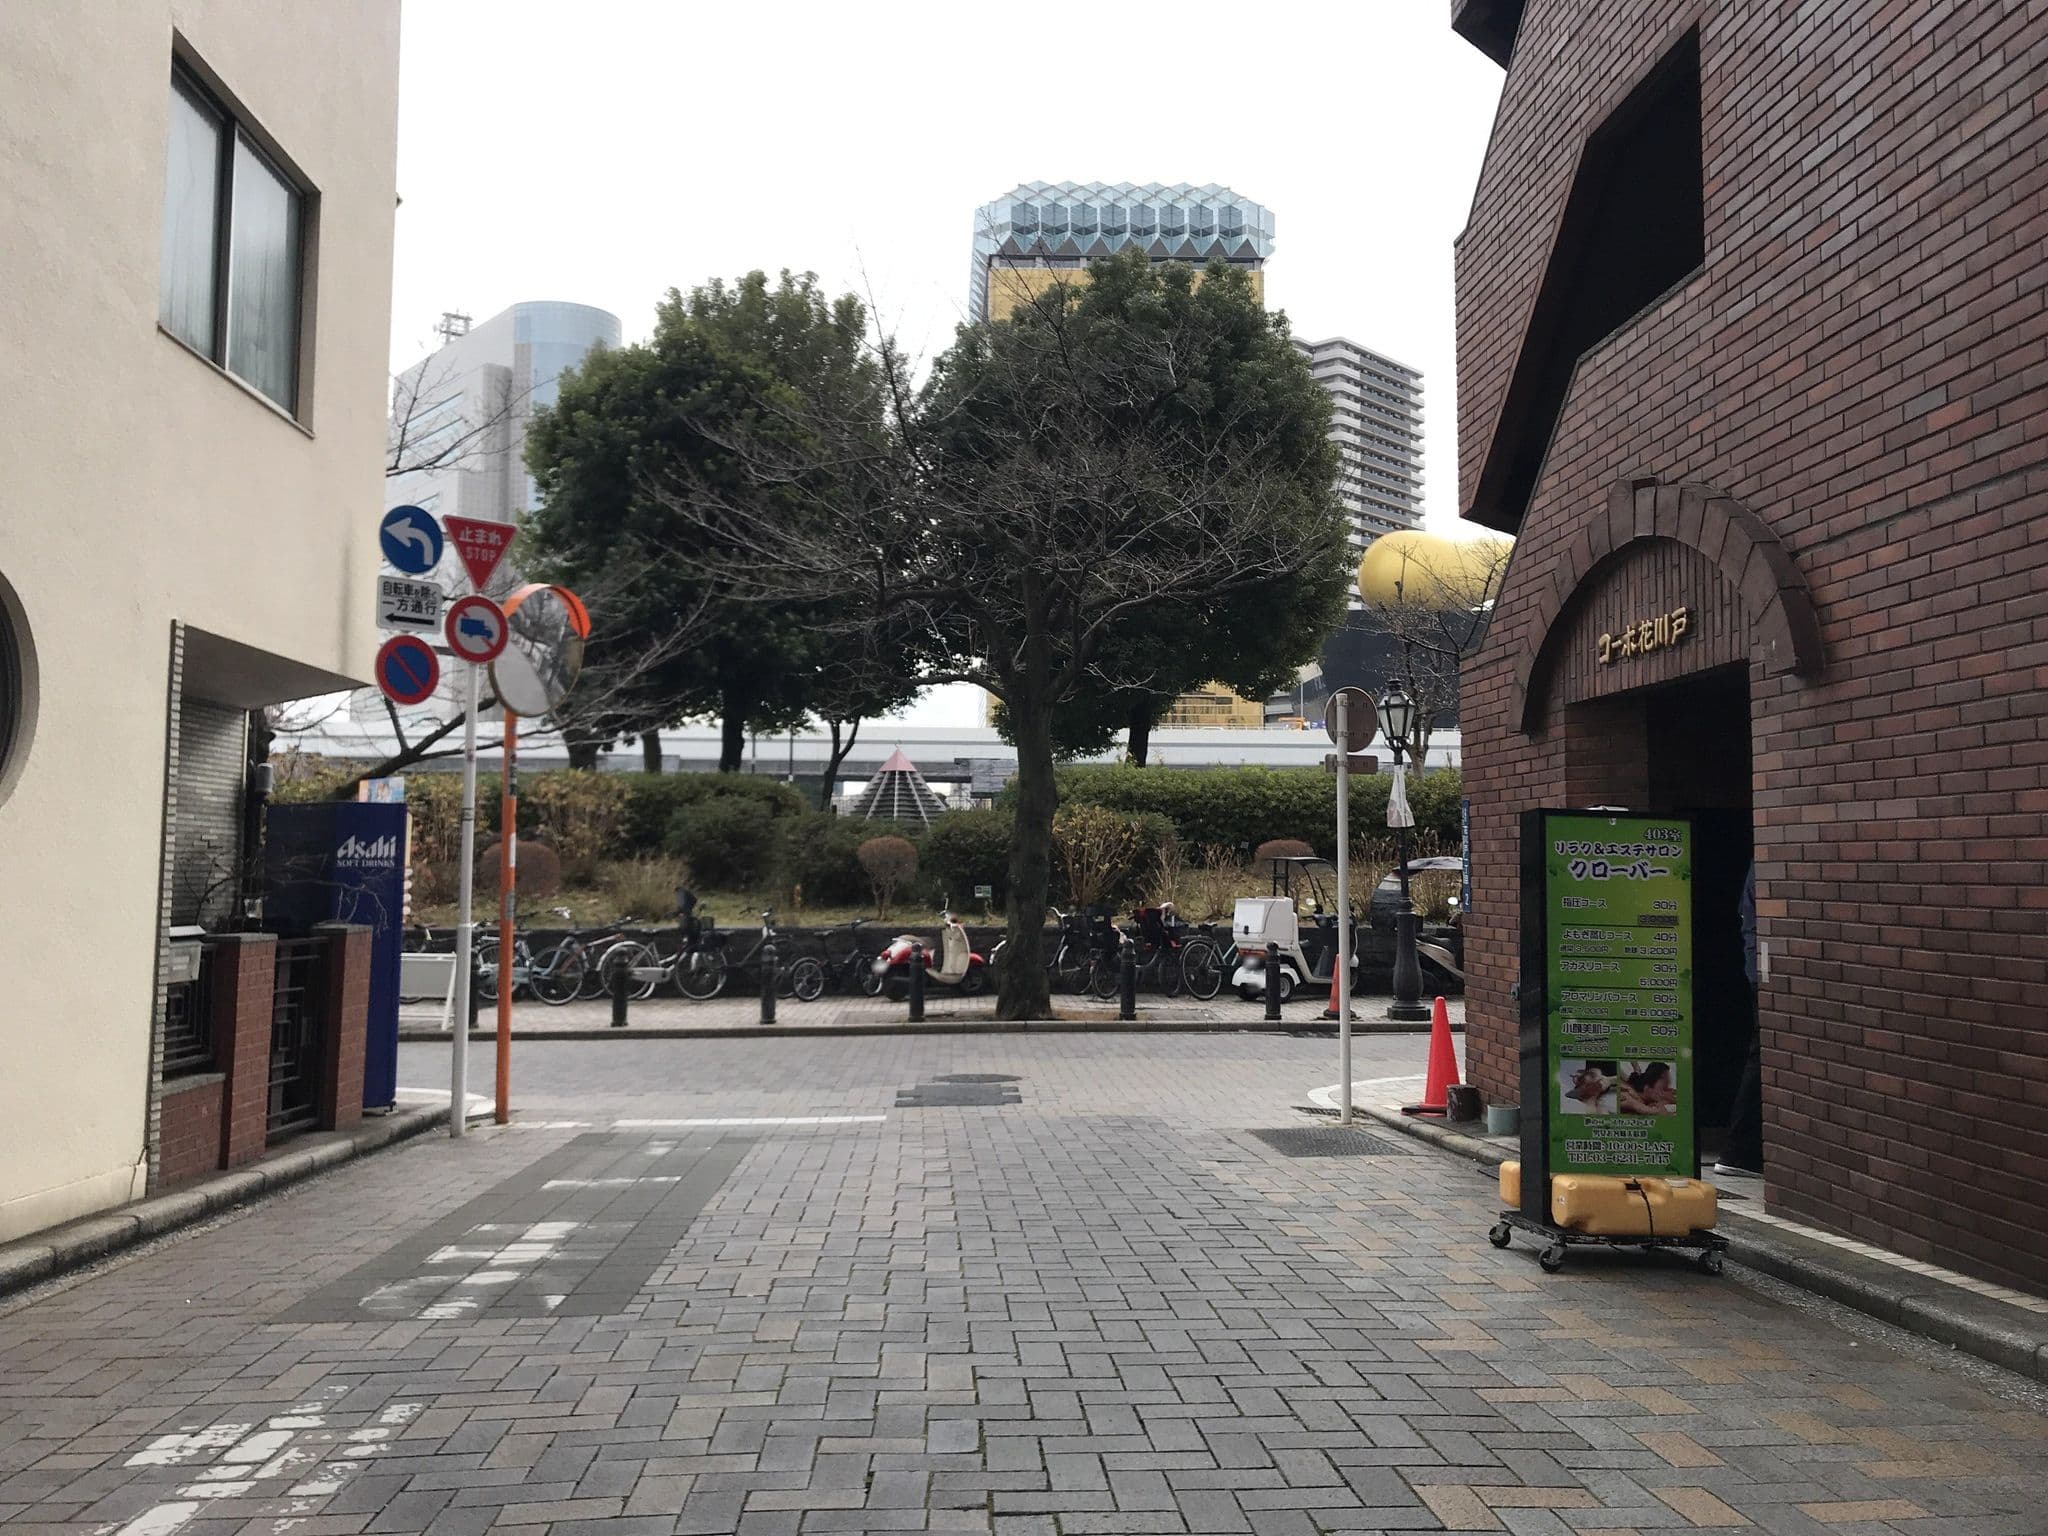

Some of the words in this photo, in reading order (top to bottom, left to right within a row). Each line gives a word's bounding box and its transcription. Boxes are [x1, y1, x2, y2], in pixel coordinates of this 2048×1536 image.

[458, 526, 502, 547] 止まれ
[465, 546, 497, 562] STOP
[383, 581, 438, 600] 自転車を除く
[382, 599, 437, 615] 一方通行
[1644, 827, 1682, 842] 403室
[337, 834, 397, 859] Asahi
[1555, 841, 1682, 857] リラク&エステサロン
[336, 859, 359, 868] SOFT
[362, 859, 396, 869] DRINKS
[1569, 860, 1668, 879] クローバー
[1562, 897, 1607, 908] 指圧コース
[1653, 901, 1677, 911] 30分
[1563, 929, 1633, 941] よもぎ蒸しコース
[1654, 932, 1677, 943] 40分
[1560, 961, 1620, 972] アカスリコース
[1653, 963, 1677, 973] 30分
[1562, 991, 1637, 1003] アロマリンパコース
[1653, 994, 1677, 1004] 60分
[1562, 1023, 1630, 1035] 小顔美肌コース
[1650, 1025, 1678, 1036] 60分
